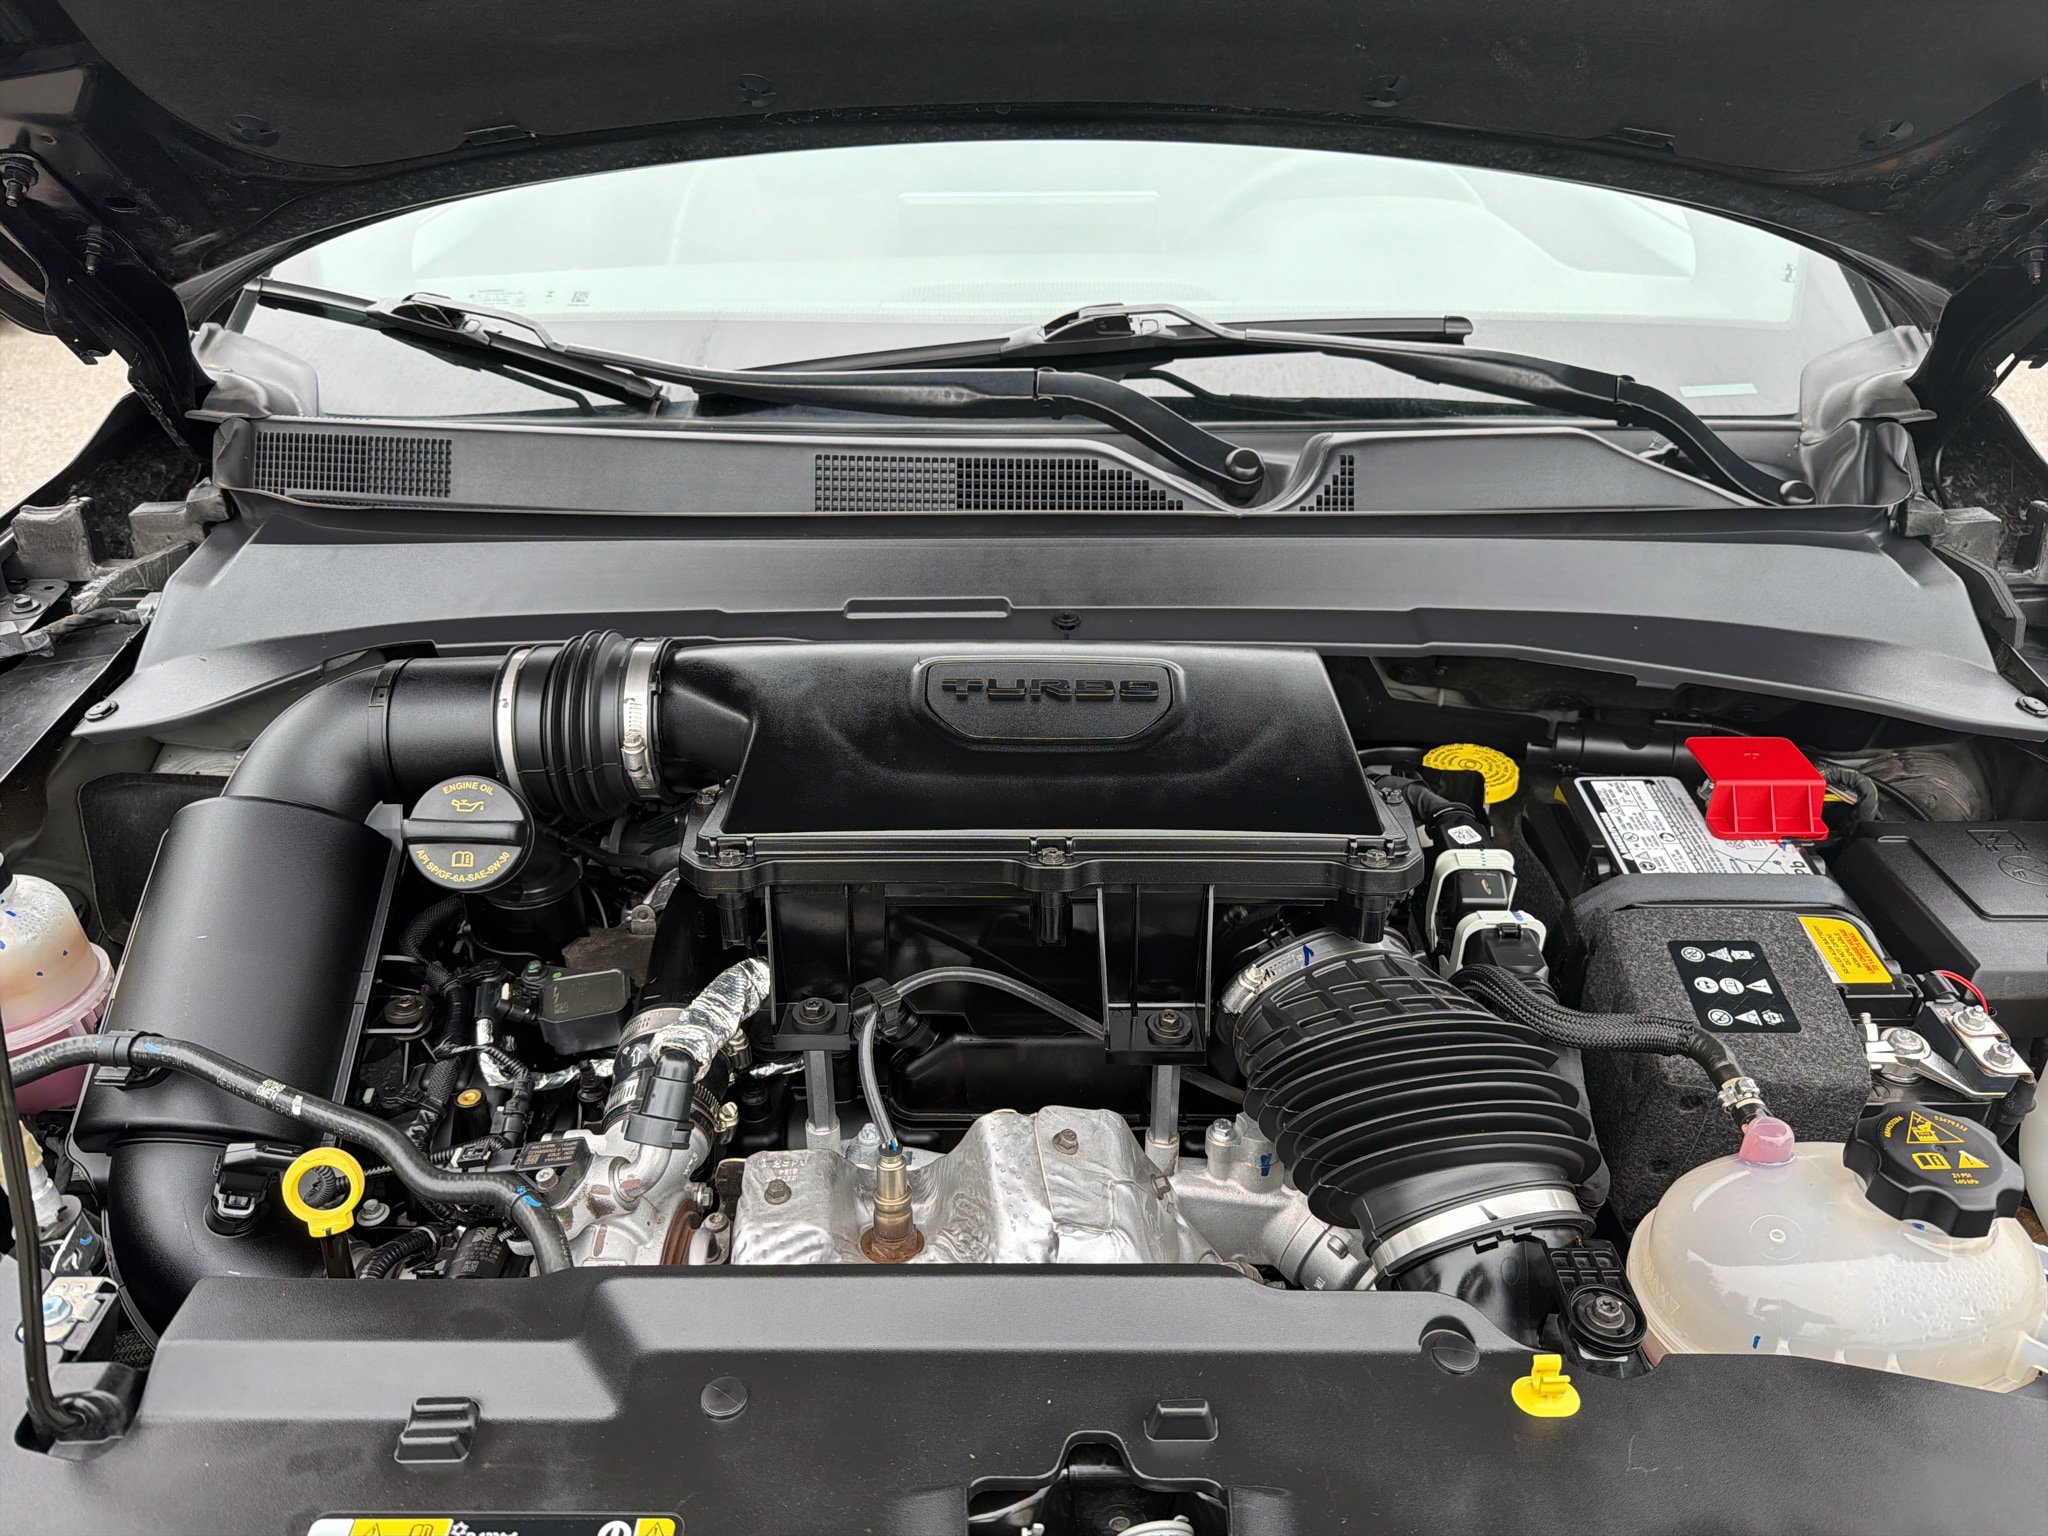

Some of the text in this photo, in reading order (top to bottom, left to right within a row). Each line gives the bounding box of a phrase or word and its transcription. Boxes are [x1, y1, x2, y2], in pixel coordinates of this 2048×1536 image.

[941, 677, 1160, 701] TURBO
[443, 781, 494, 795] ENGINE OIL
[416, 849, 430, 864] API
